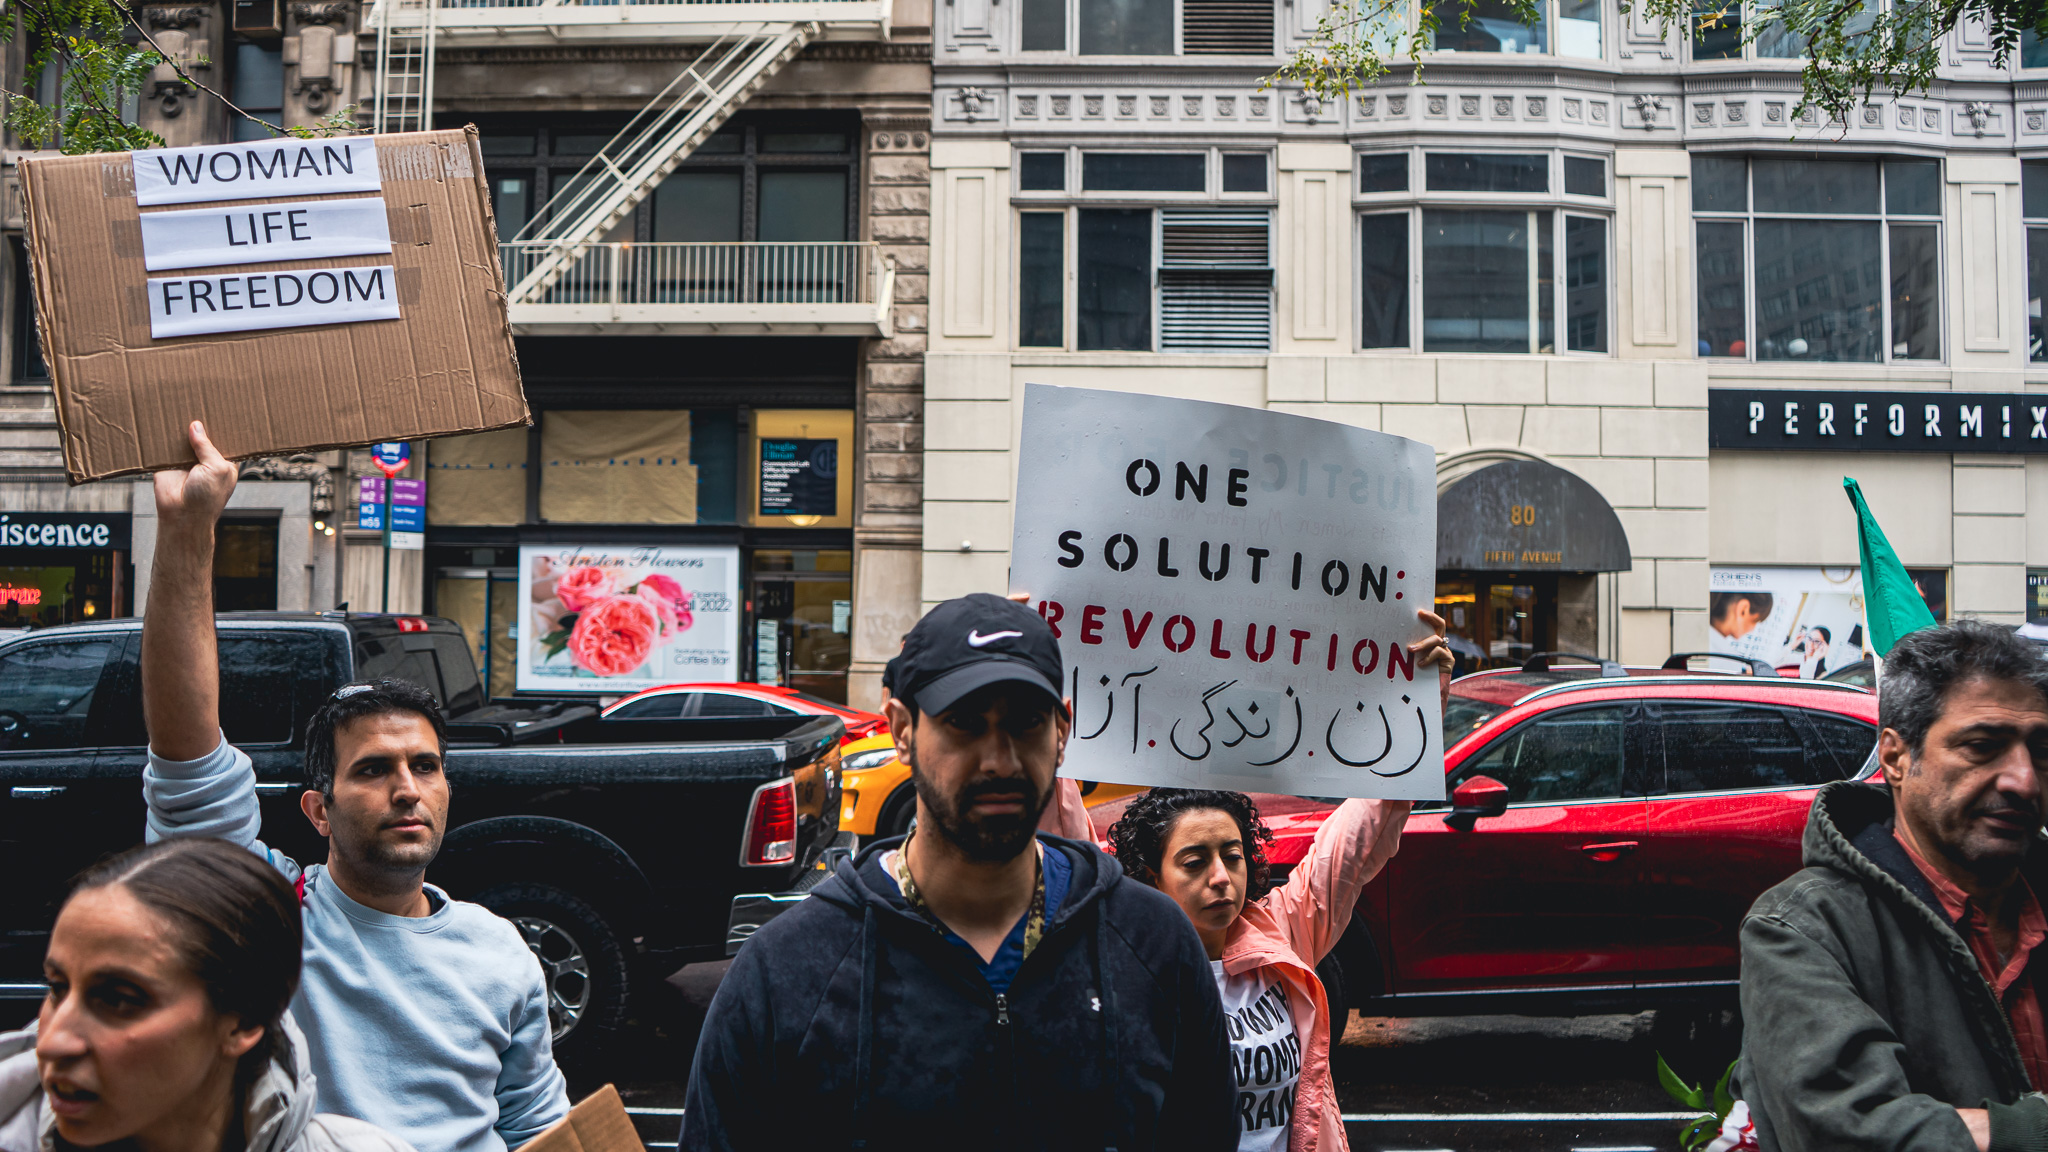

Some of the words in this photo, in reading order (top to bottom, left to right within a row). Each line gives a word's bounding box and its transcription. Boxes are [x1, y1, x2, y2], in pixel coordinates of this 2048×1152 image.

[156, 143, 355, 187] WOMAN
[223, 208, 312, 248] LIFE
[161, 268, 387, 317] FREEDOM
[1749, 400, 2048, 439] PERFORMIX
[1125, 457, 1251, 508] ONE
[1510, 505, 1535, 526] 80
[552, 545, 625, 568] Ariston
[628, 545, 704, 568] Flowers
[1056, 529, 1406, 603] SOLUTION:
[1484, 551, 1515, 563] FIFTH
[1521, 551, 1563, 564] AVENUE
[700, 597, 733, 612] 2022
[673, 653, 709, 666] Coffee
[1037, 599, 1416, 682] REVOLUTION
